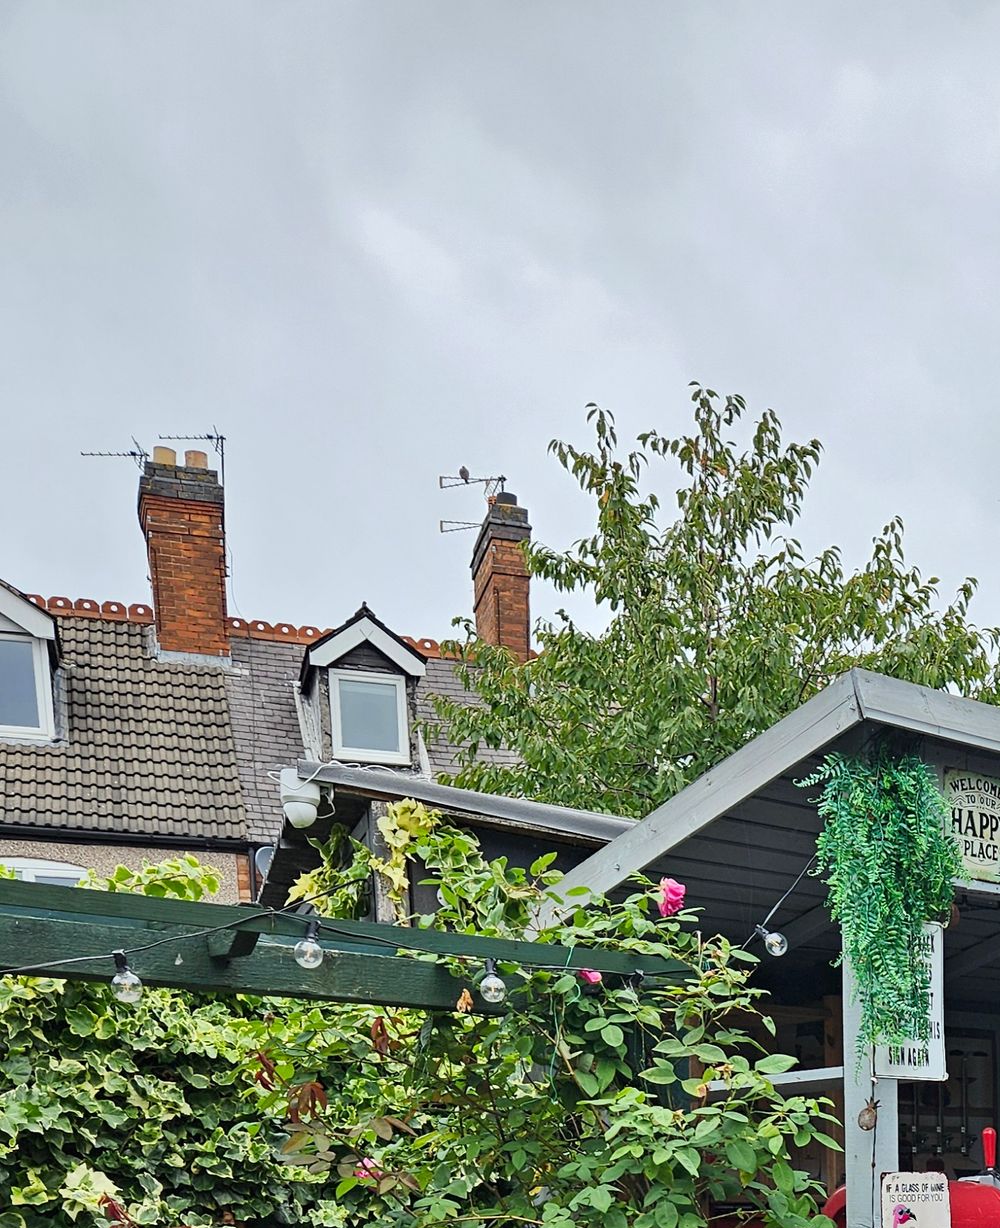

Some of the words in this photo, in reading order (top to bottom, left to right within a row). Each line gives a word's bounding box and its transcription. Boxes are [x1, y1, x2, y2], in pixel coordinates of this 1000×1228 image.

[965, 794, 976, 804] TO
[980, 797, 997, 809] OUR
[964, 840, 998, 860] PLACE
[895, 1183, 900, 1192] A
[902, 1183, 920, 1192] GLASS
[922, 1183, 929, 1192] OF
[897, 1193, 916, 1202] GOOD
[918, 1193, 930, 1202] FOR
[930, 1193, 943, 1202] YOU
